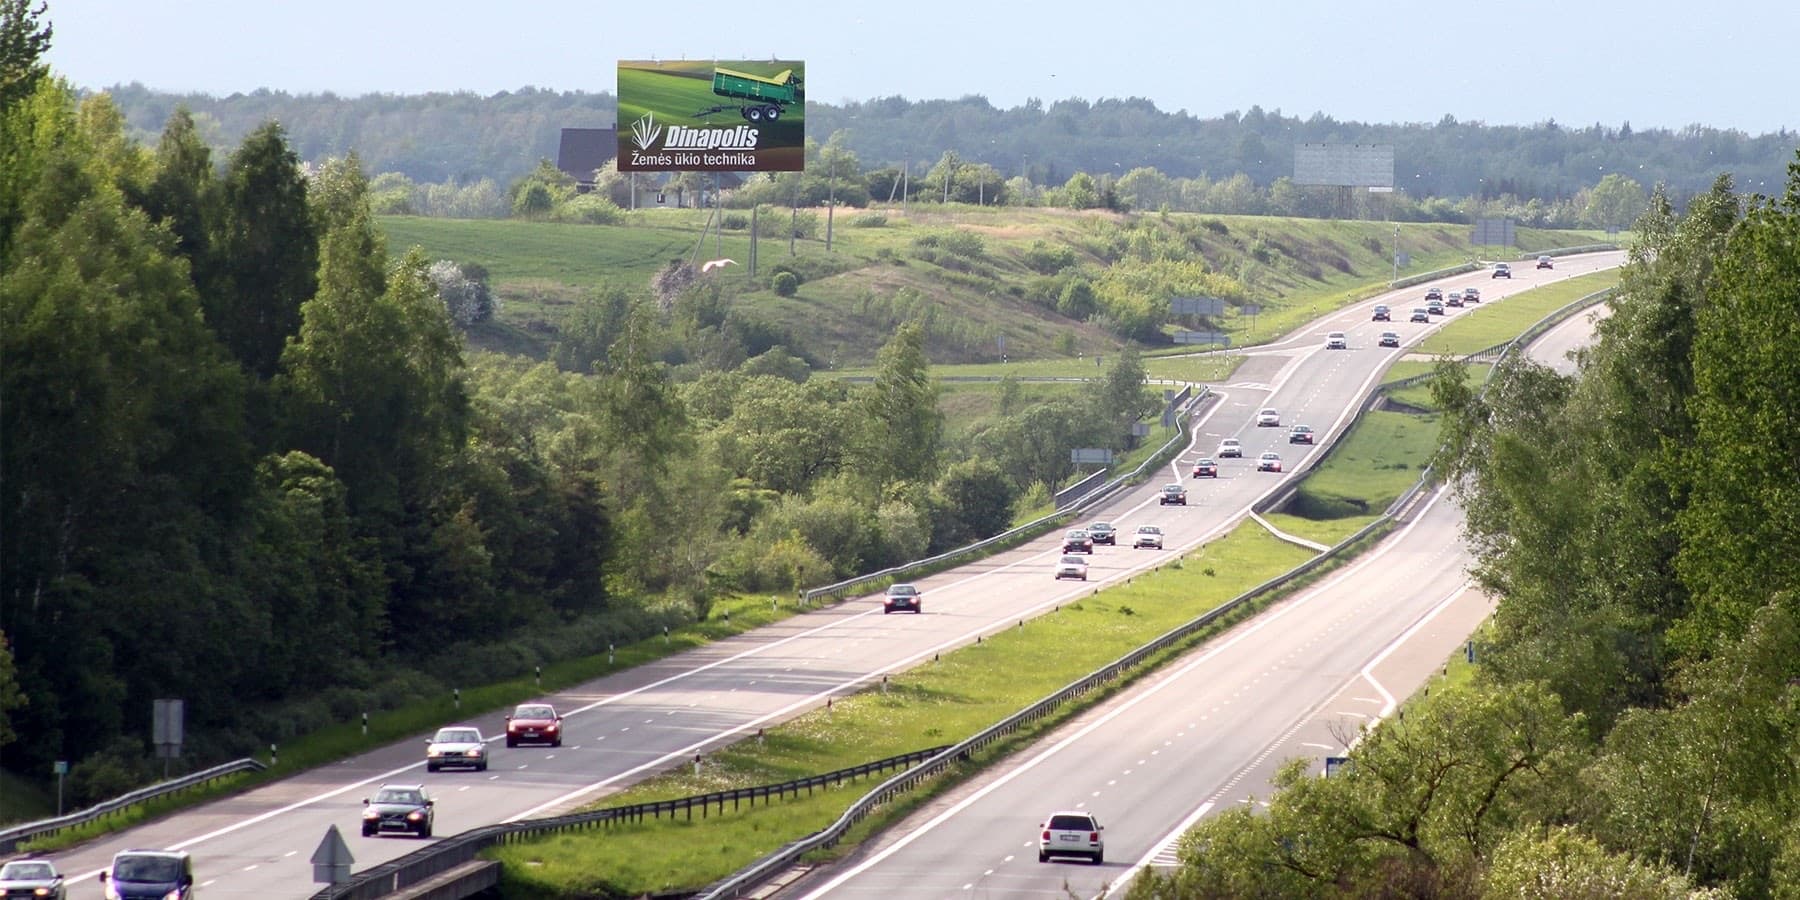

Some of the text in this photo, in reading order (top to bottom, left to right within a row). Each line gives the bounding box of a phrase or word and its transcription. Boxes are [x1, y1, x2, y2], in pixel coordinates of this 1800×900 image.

[664, 125, 759, 149] Dinapolis
[631, 150, 756, 166] Žemės ūkio technika
